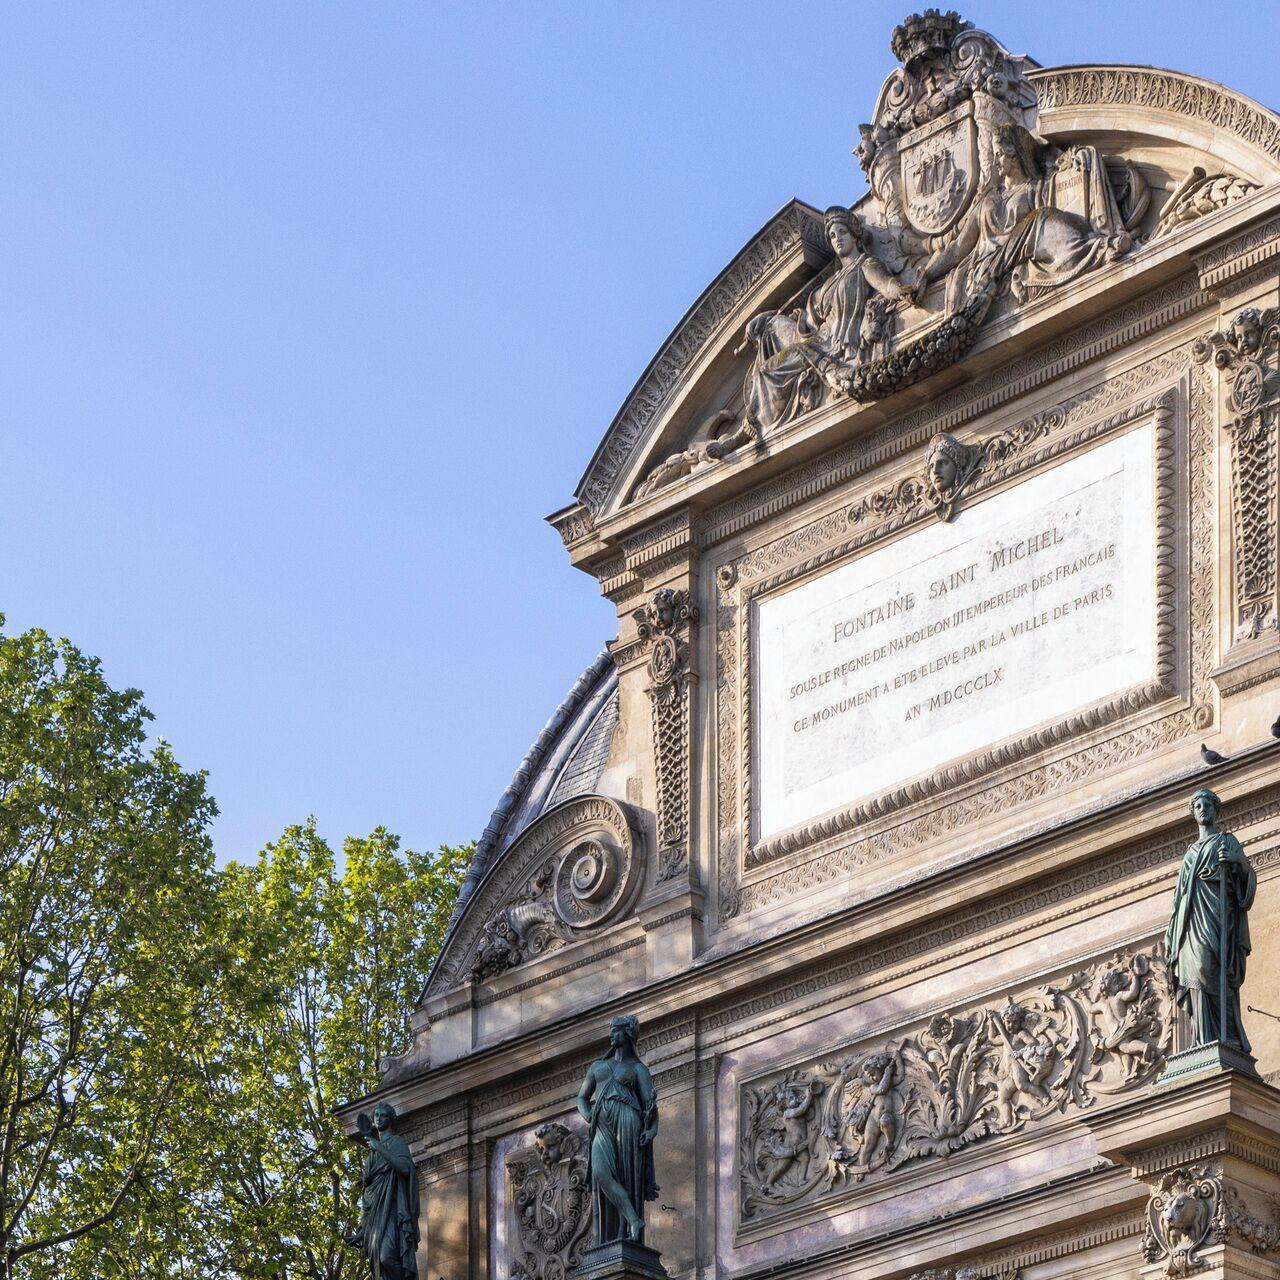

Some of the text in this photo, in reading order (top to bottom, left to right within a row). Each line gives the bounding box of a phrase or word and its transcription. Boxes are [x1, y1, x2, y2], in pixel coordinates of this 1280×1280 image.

[790, 544, 1115, 699] SOUS LE REGNE DE NAPOLEON III EMPEREUR DES FRANCAIS
[834, 528, 1064, 643] FONTAINE SAINT MICHEL
[793, 584, 1113, 733] CE MONUMENT A ETE ELEVE PAR LA VILLE DE PARIS
[905, 667, 1003, 722] AN MDCCCLX
